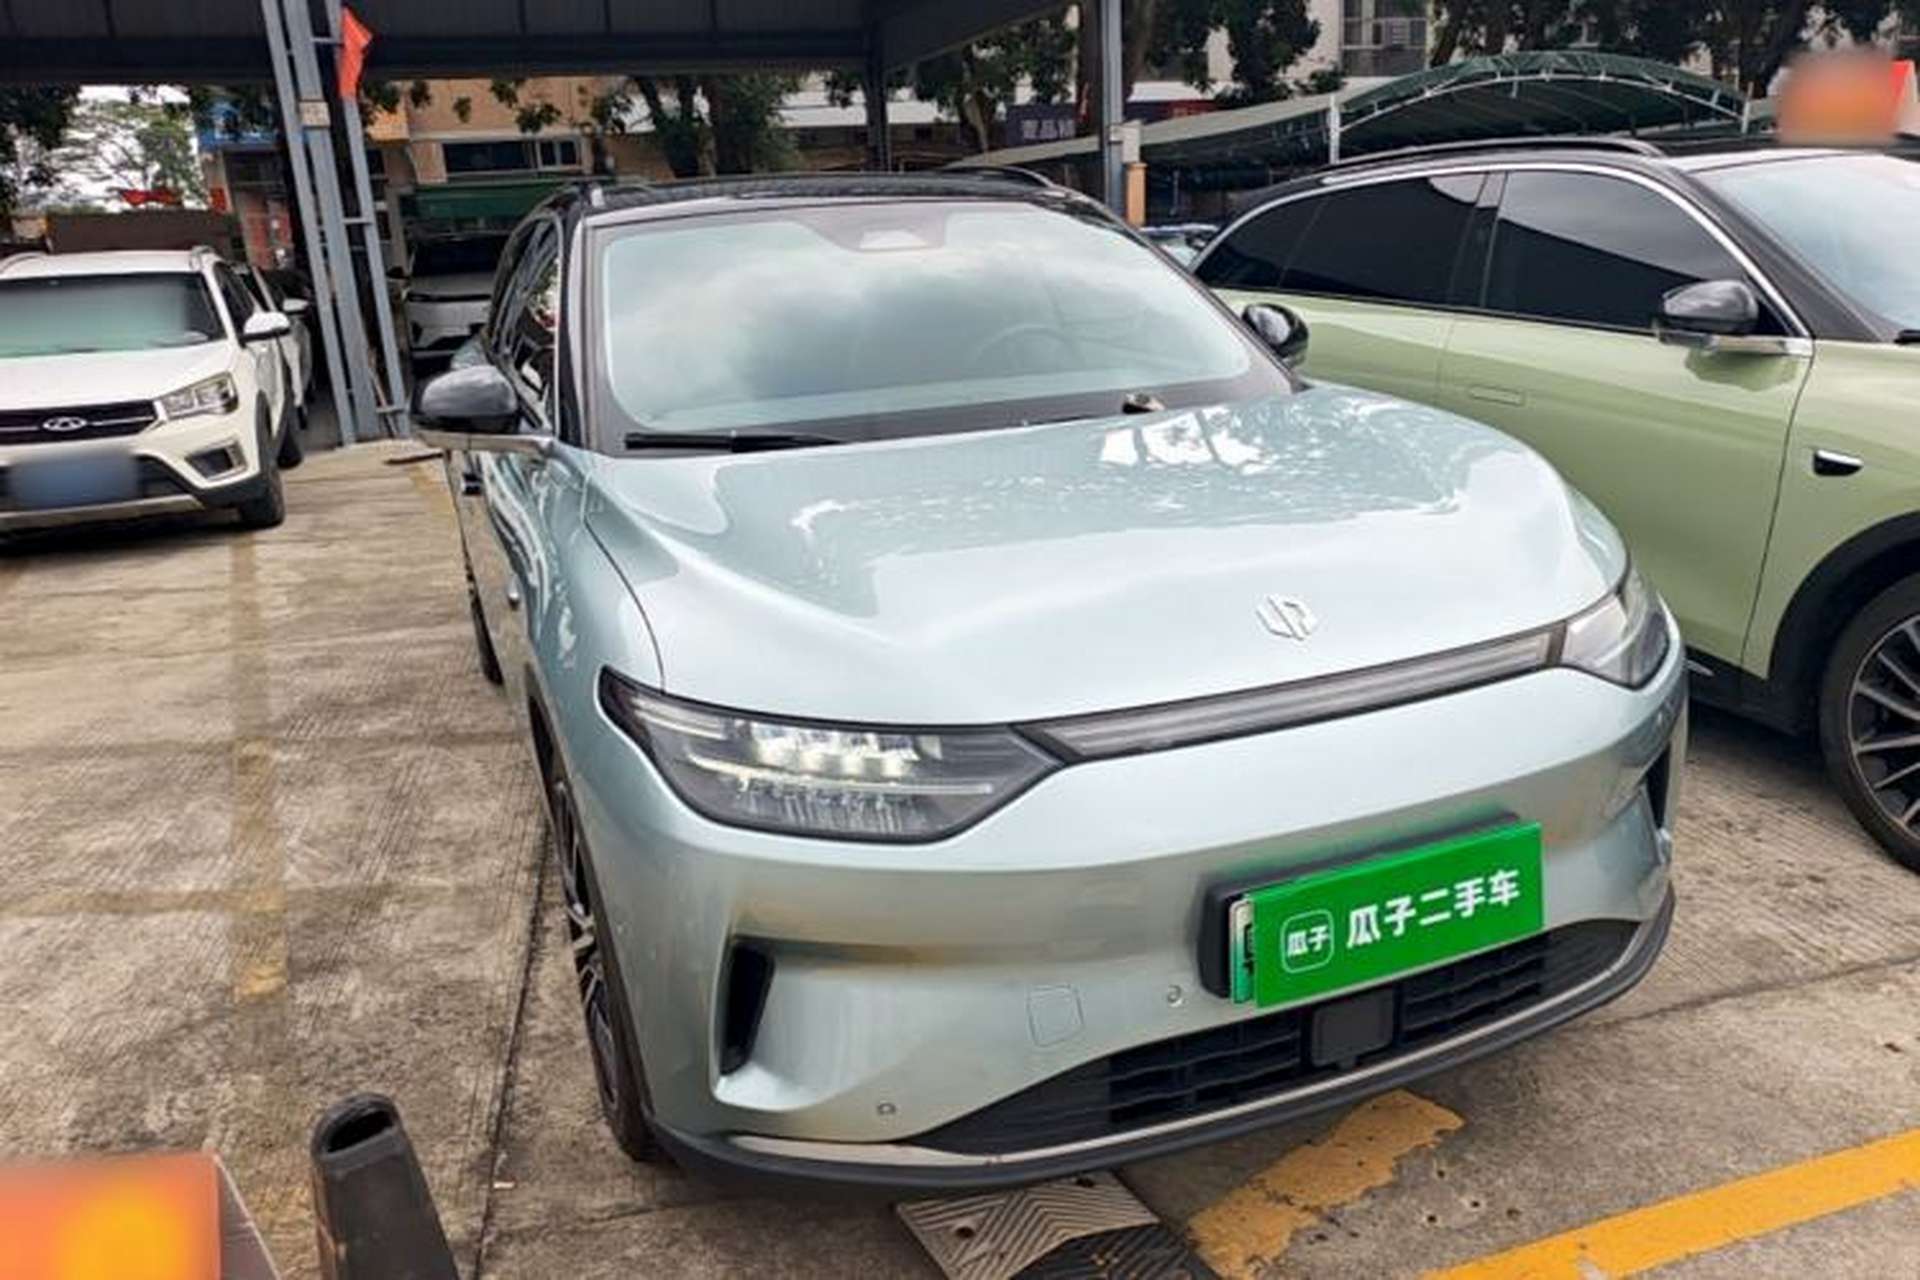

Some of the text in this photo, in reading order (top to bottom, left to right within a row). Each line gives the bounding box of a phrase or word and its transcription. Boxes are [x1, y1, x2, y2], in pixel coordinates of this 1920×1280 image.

[1346, 869, 1521, 948] 瓜子二手车
[1287, 925, 1330, 957] 瓜子
